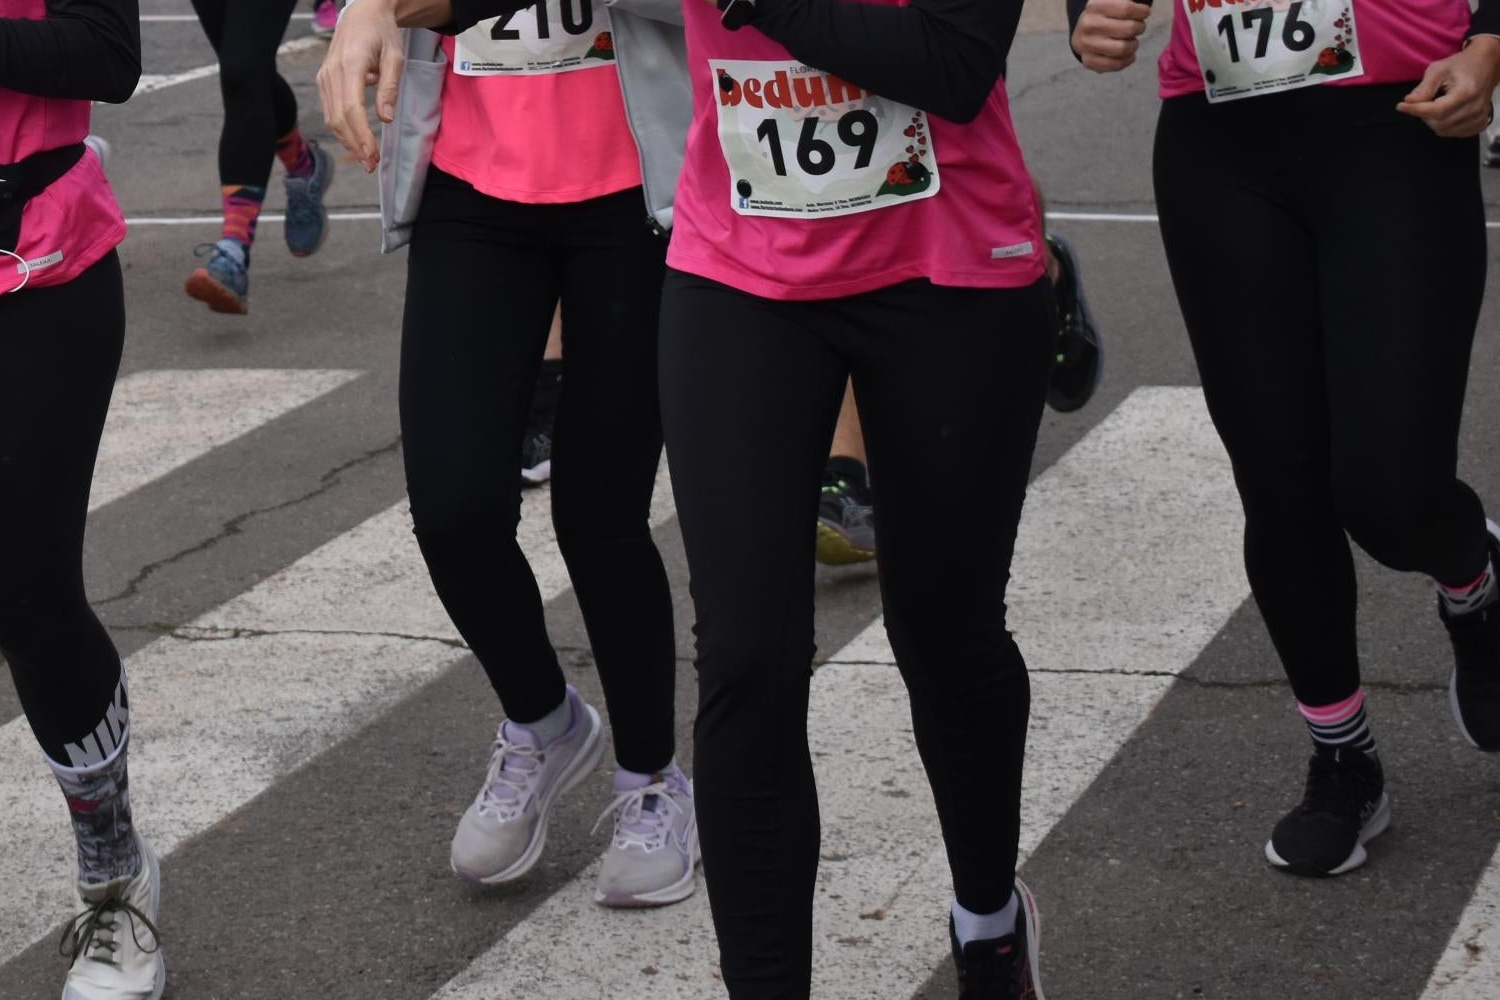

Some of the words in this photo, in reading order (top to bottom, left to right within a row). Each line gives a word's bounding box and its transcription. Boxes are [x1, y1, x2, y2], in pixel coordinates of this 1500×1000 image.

[1217, 2, 1315, 63] 176
[716, 69, 868, 108] bedun
[756, 110, 879, 176] 169
